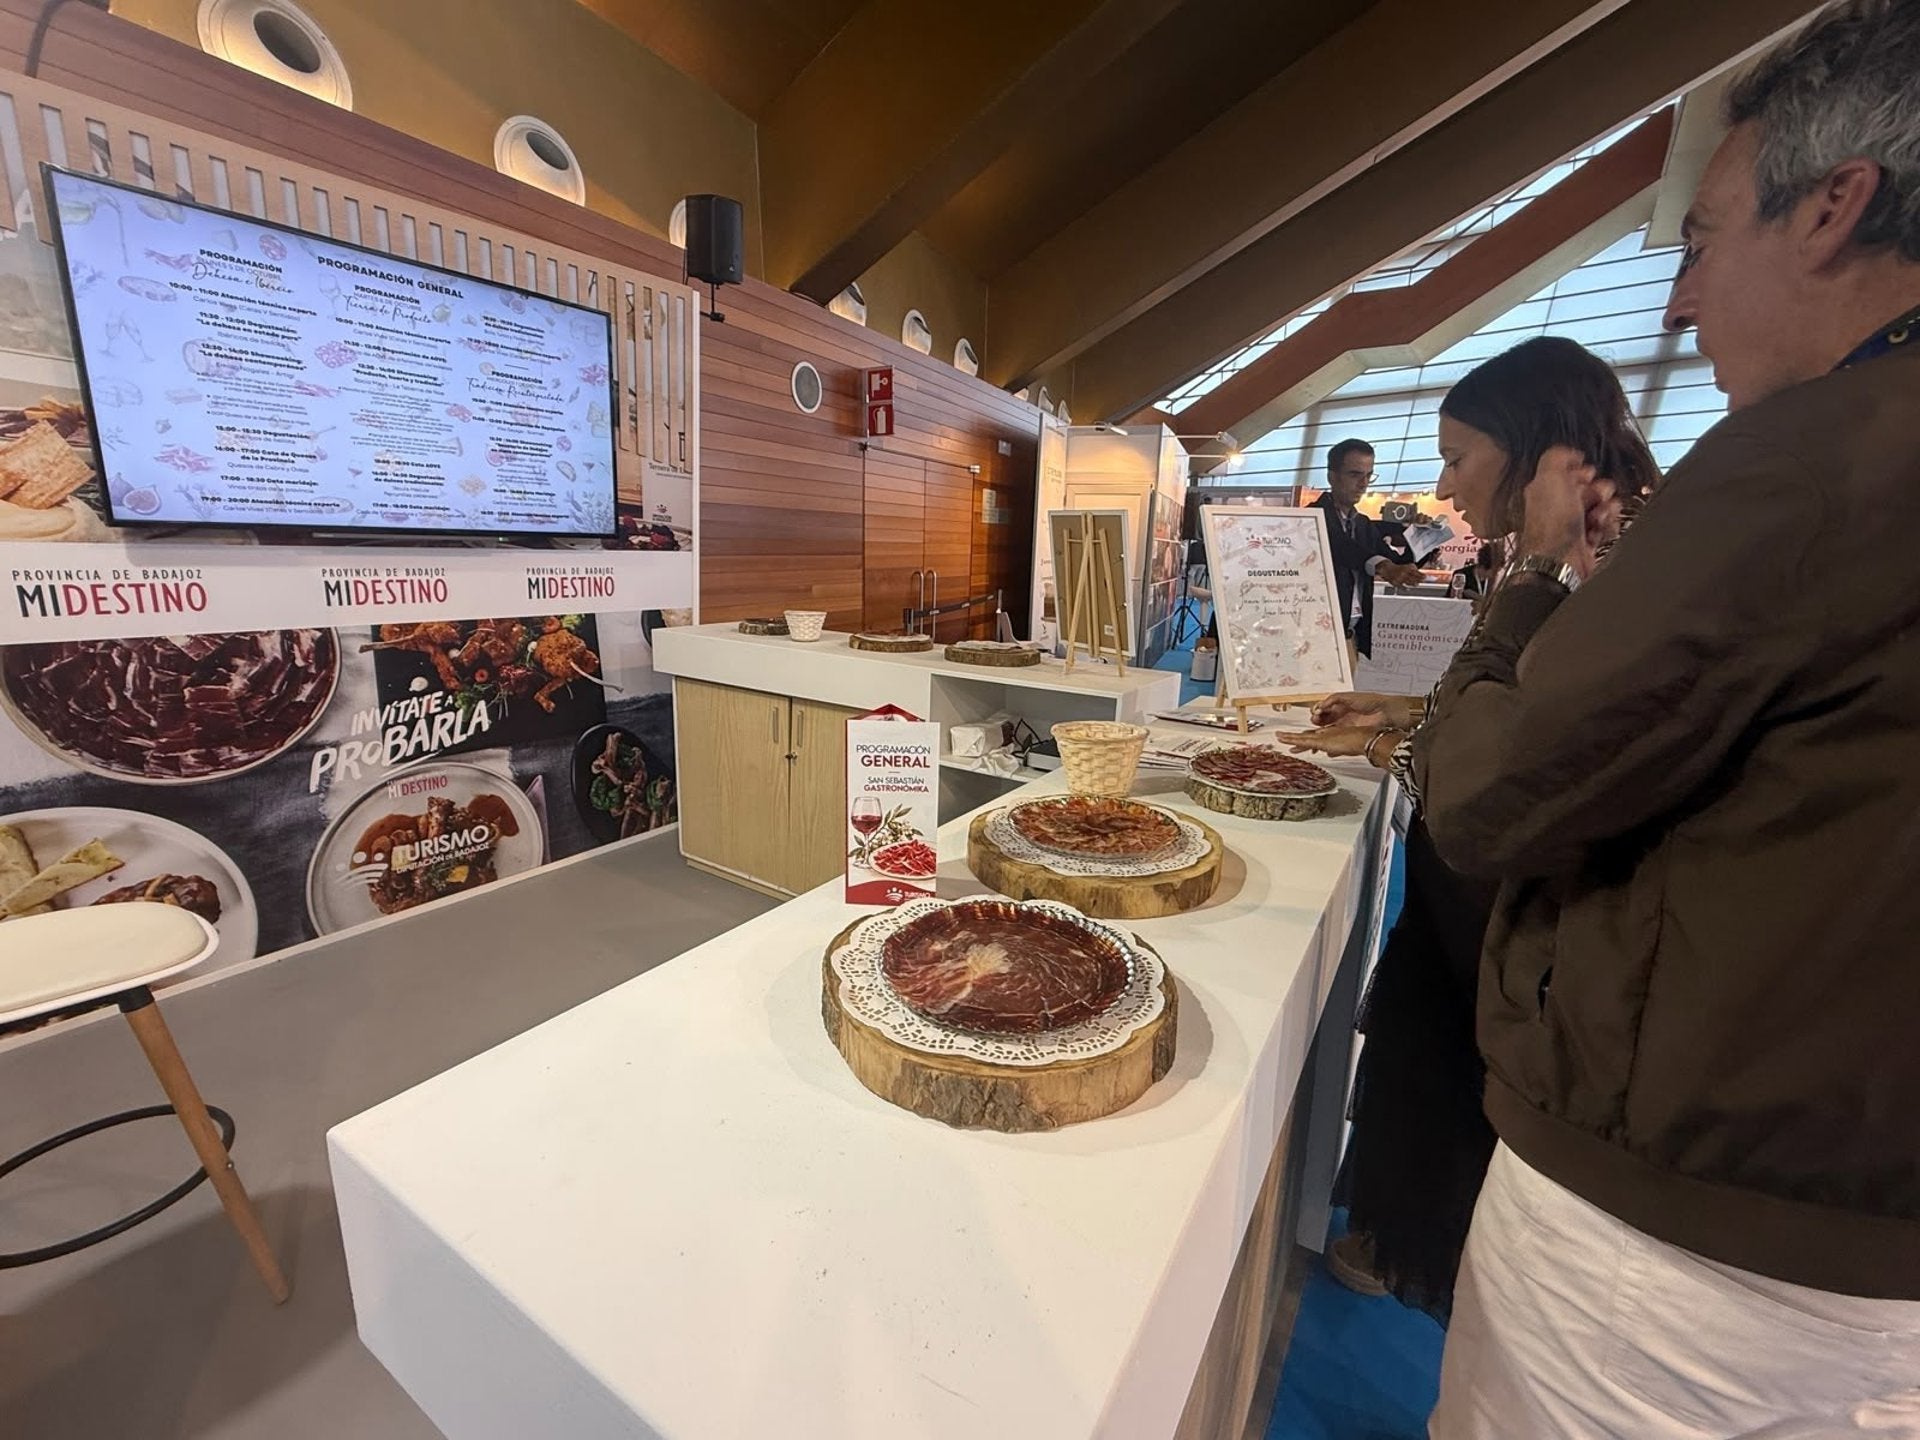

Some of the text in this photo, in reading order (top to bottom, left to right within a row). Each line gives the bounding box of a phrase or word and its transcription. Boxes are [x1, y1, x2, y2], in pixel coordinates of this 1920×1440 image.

[199, 248, 282, 273] PROGRAMACIÓN
[191, 261, 243, 283] Dehesa
[317, 255, 464, 299] PROGRAMACIÓN GENERAL
[168, 281, 287, 310] 10:00 11:00 Atención técnica
[354, 284, 421, 305] PROGRAMACIÓN
[199, 311, 219, 320] 11:30
[211, 321, 242, 332] dehesa
[253, 328, 280, 339] estado
[335, 316, 428, 340] 10:00 11:00 Atención técnica
[214, 351, 243, 362] dehesa
[491, 370, 543, 384] PROGRAMACIÓN
[260, 456, 296, 464] Provincia
[261, 449, 280, 457] Cata
[226, 461, 254, 469] Quesos
[219, 474, 241, 482] 17:00
[266, 477, 284, 485] Cata
[1439, 544, 1478, 555] eorgia
[11, 568, 203, 581] PROVINCIA DE BADAJOZ
[321, 567, 448, 578] PROVINCIA DE BADAJOZ
[526, 567, 615, 576] PROVINCIA DE BADAJOZ
[1247, 567, 1300, 577] DEGUSTACIÓN
[323, 578, 449, 607] MIDESTINO
[527, 575, 616, 600] MIDESTINO
[15, 581, 208, 618] MIDESTINO
[1377, 622, 1430, 631] EXTREMADURA
[350, 691, 454, 737] INVÍTATE A
[309, 699, 492, 794] PROBARLA
[856, 744, 931, 755] PROGRAMACIÓN
[861, 754, 931, 769] GENERAL
[388, 775, 449, 799] MIDESTINO
[867, 776, 925, 786] SAN SEBASTIÁN
[863, 783, 930, 794] GASTRONÓMIKA
[391, 824, 490, 864] TURISMO
[396, 853, 445, 874] DIPUTACIÓN
[454, 841, 490, 859] BADAJOZ
